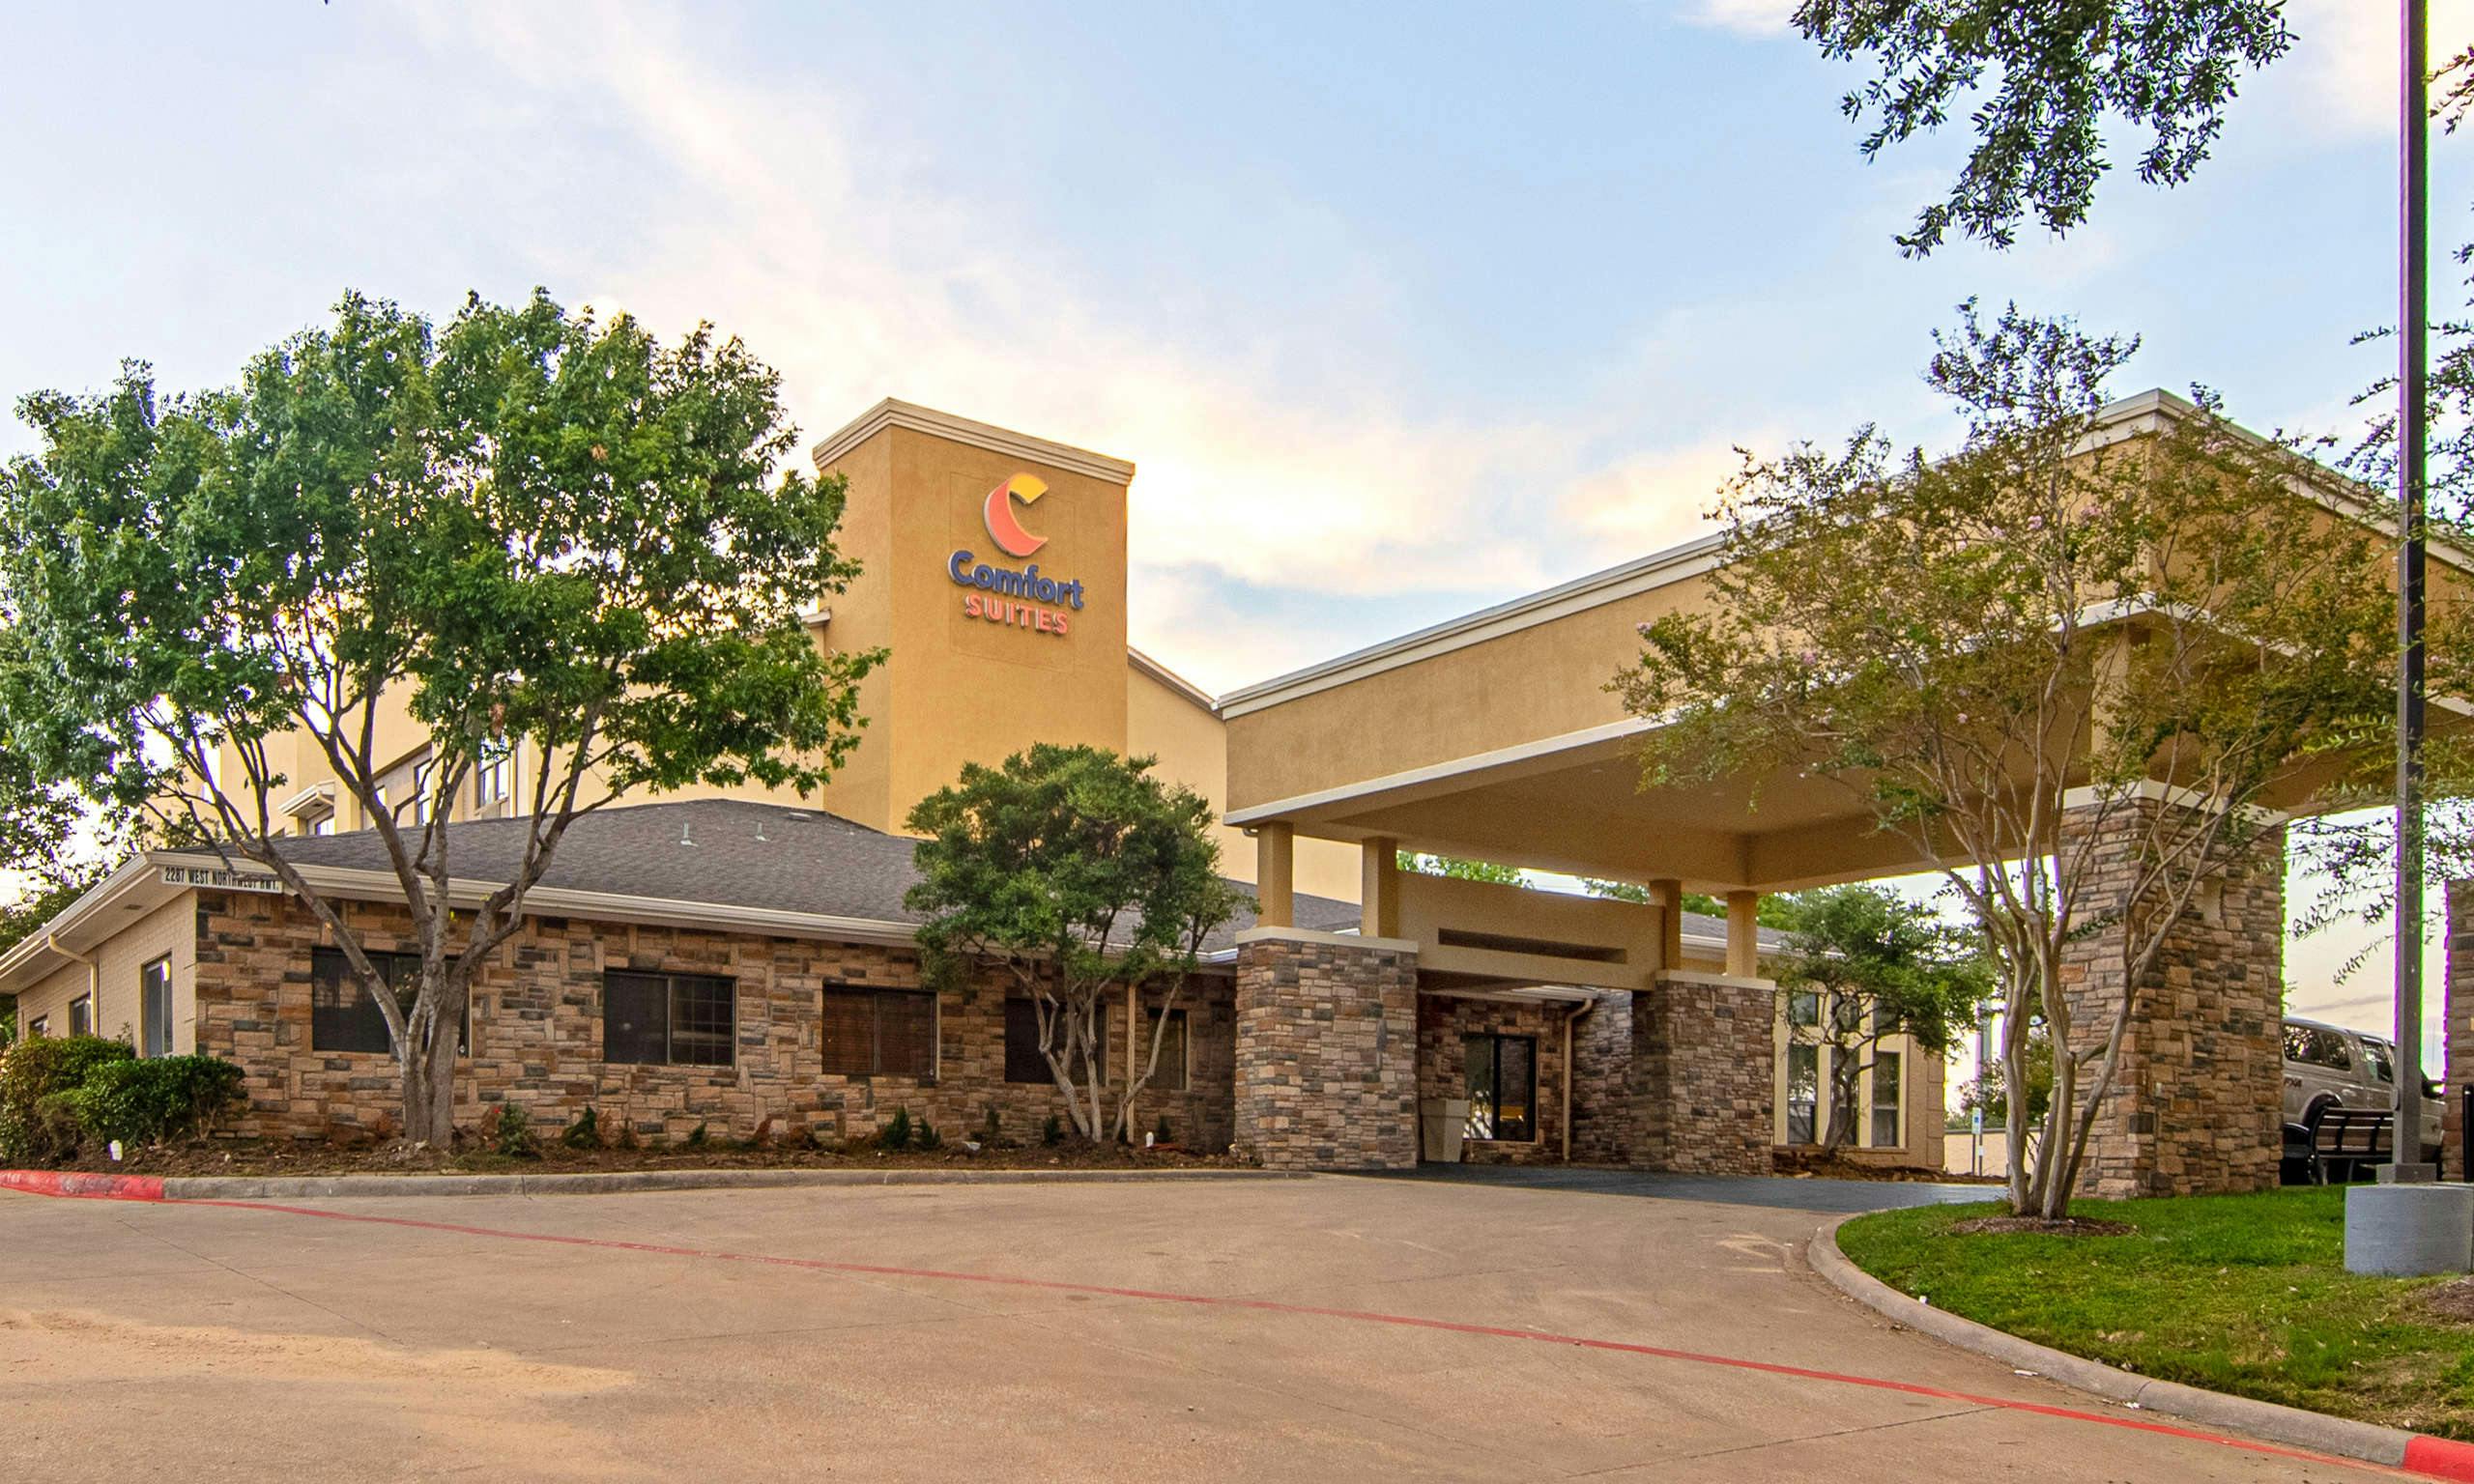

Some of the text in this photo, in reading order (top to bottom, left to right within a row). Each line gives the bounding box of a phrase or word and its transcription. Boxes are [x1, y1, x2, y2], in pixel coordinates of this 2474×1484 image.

[948, 550, 1084, 610] Comfort
[965, 592, 1068, 635] SUITES
[164, 867, 186, 882] 2287
[187, 869, 210, 885] WEST
